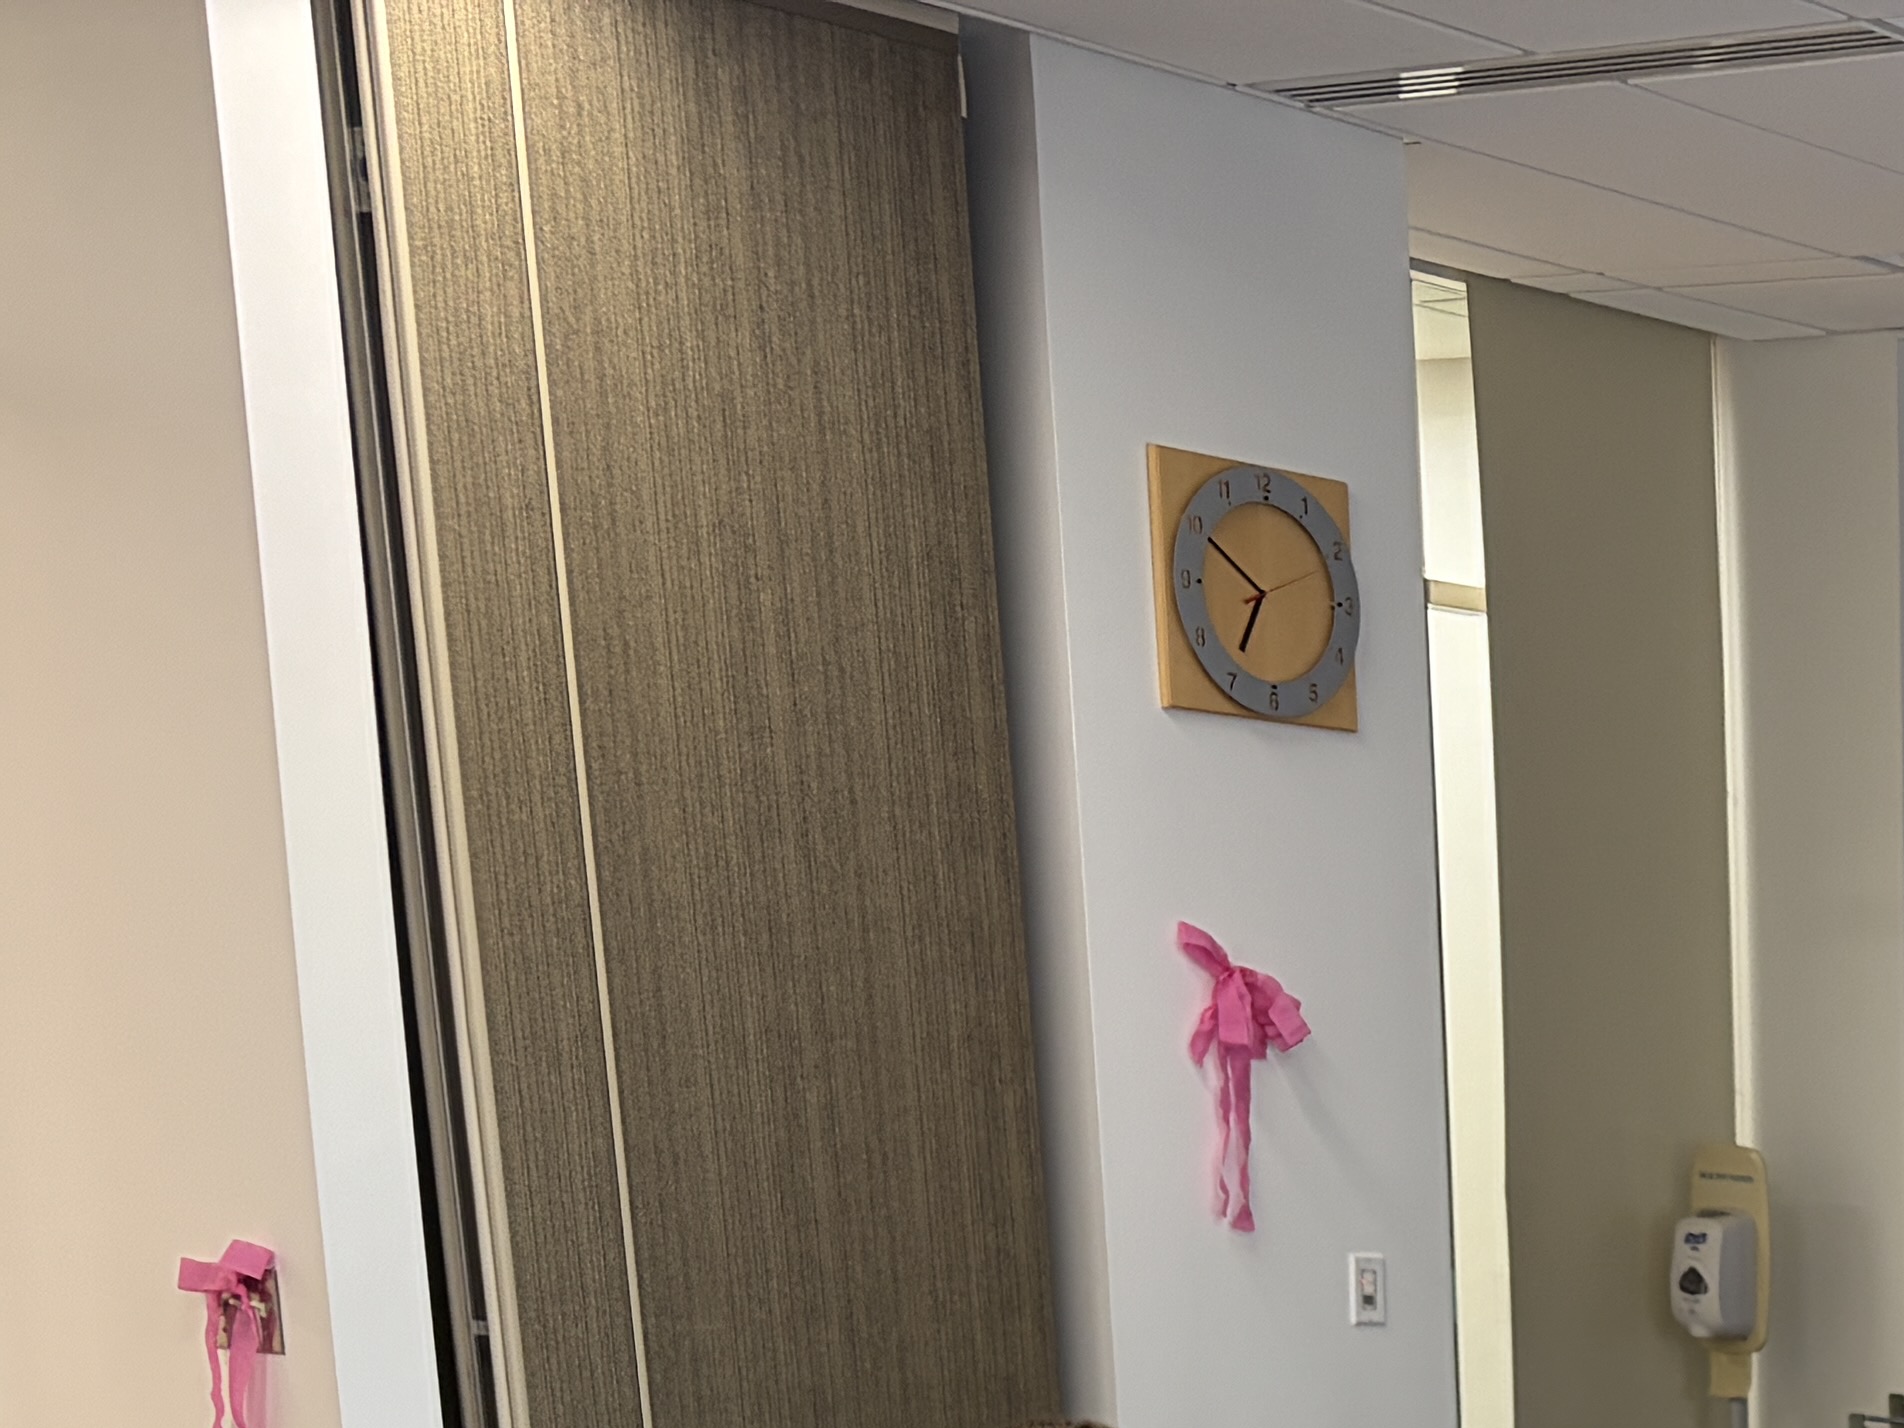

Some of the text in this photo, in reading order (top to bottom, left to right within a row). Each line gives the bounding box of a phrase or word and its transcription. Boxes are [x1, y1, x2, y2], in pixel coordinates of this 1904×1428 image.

[1217, 480, 1230, 500] 11
[1255, 473, 1271, 493] 12
[1301, 497, 1309, 516] 1
[1187, 516, 1203, 535] 10
[1334, 542, 1343, 561] 2
[1181, 570, 1191, 588] 9
[1345, 597, 1353, 616] 3
[1195, 626, 1206, 647] 8
[1335, 648, 1343, 666] 4
[1226, 672, 1238, 692] 7
[1269, 691, 1279, 711] 6
[1309, 684, 1318, 703] 5
